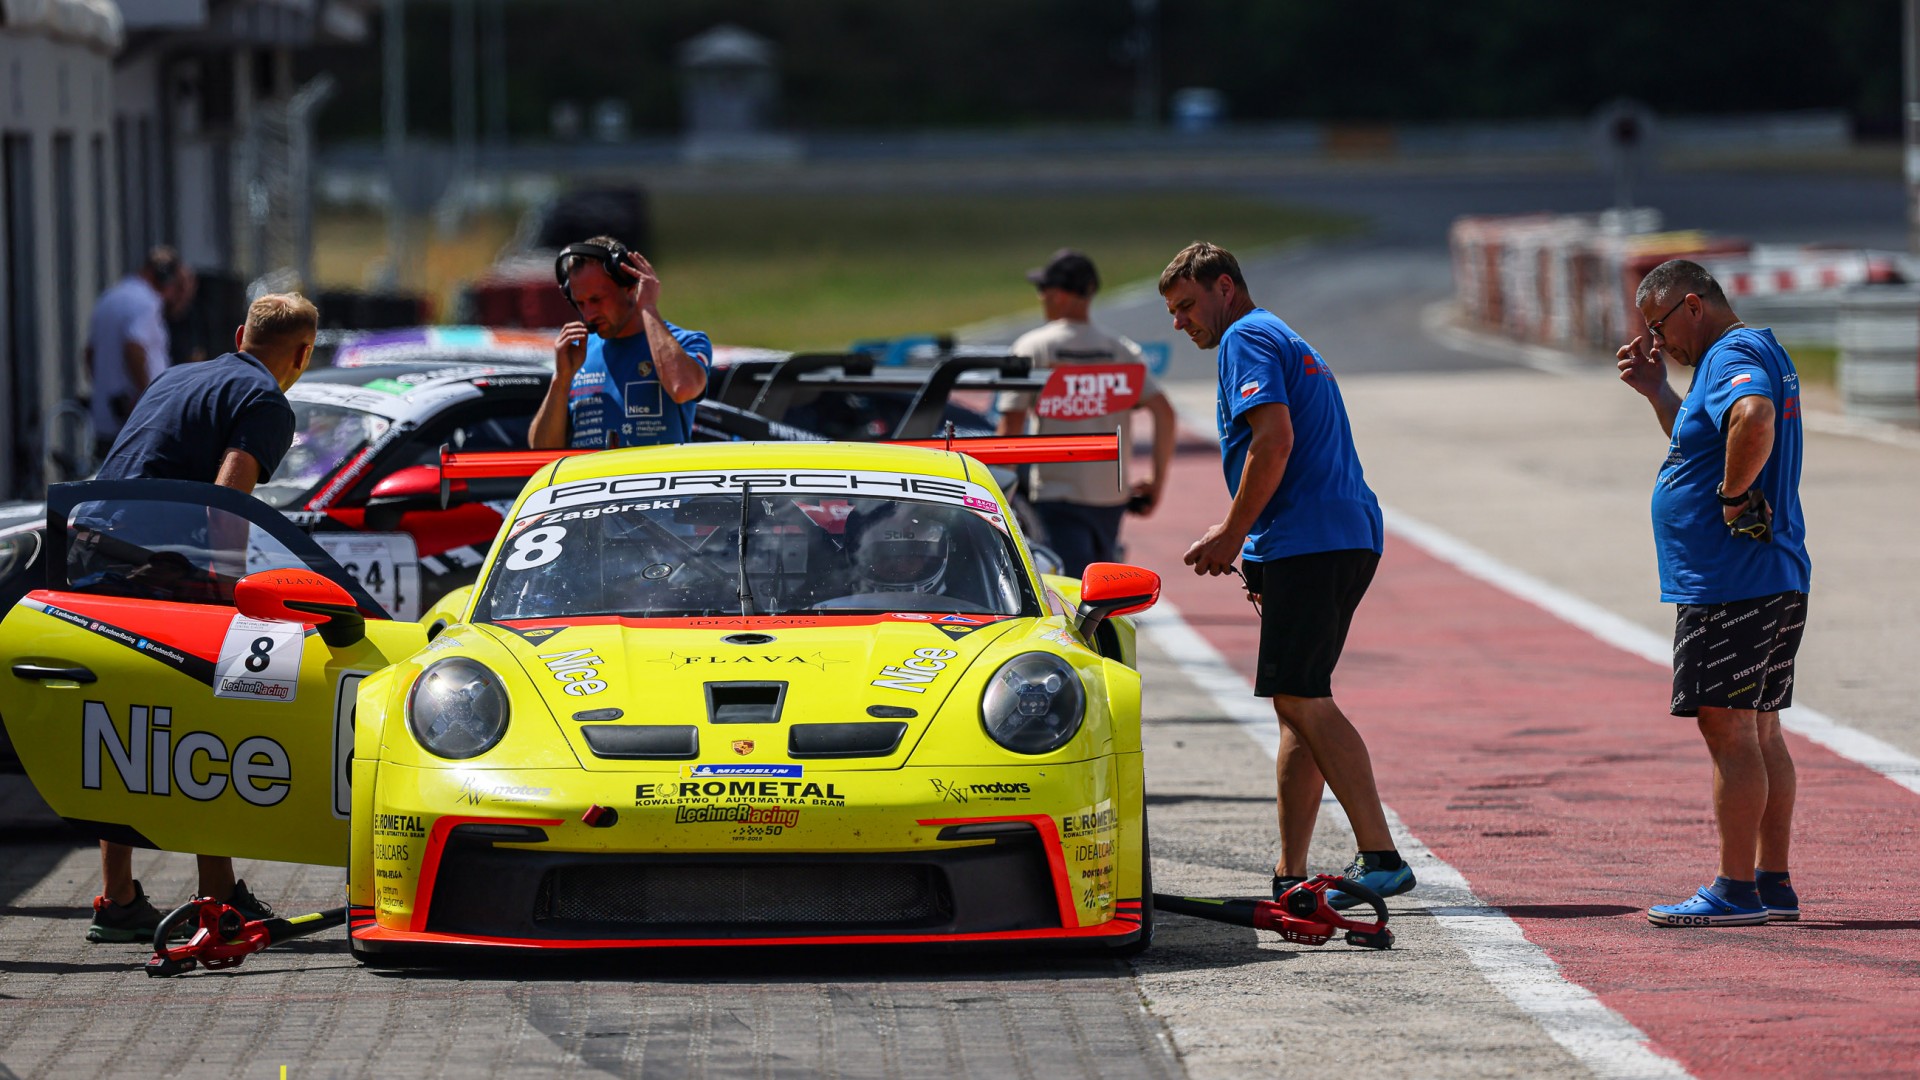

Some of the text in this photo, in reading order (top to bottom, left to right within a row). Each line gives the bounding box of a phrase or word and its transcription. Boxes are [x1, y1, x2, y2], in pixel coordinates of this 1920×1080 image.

[628, 405, 650, 414] Nice
[1039, 395, 1108, 416] #PSCCE
[549, 473, 966, 504] PORSCHE
[541, 499, 680, 526] Zagórski
[505, 525, 567, 571] 8
[277, 577, 324, 587] FLAVA
[1102, 571, 1142, 582] FLAVA
[1721, 608, 1760, 630] DISTANCE
[244, 636, 275, 673] 8
[685, 655, 807, 665] FLAVA
[1706, 652, 1738, 669] DISTANCE
[537, 647, 608, 696] Nice
[870, 647, 958, 694] Nice
[1727, 681, 1757, 699] DISTANCE
[82, 700, 291, 807] Nice
[715, 767, 790, 775] MICHELIN
[491, 784, 552, 796] motors
[970, 781, 1031, 794] motors
[635, 796, 709, 807] KOWALSTWO
[725, 796, 806, 805] AUTOMATYKA
[812, 798, 845, 807] BRAM
[765, 825, 783, 836] 50
[1667, 914, 1711, 926] crocs
